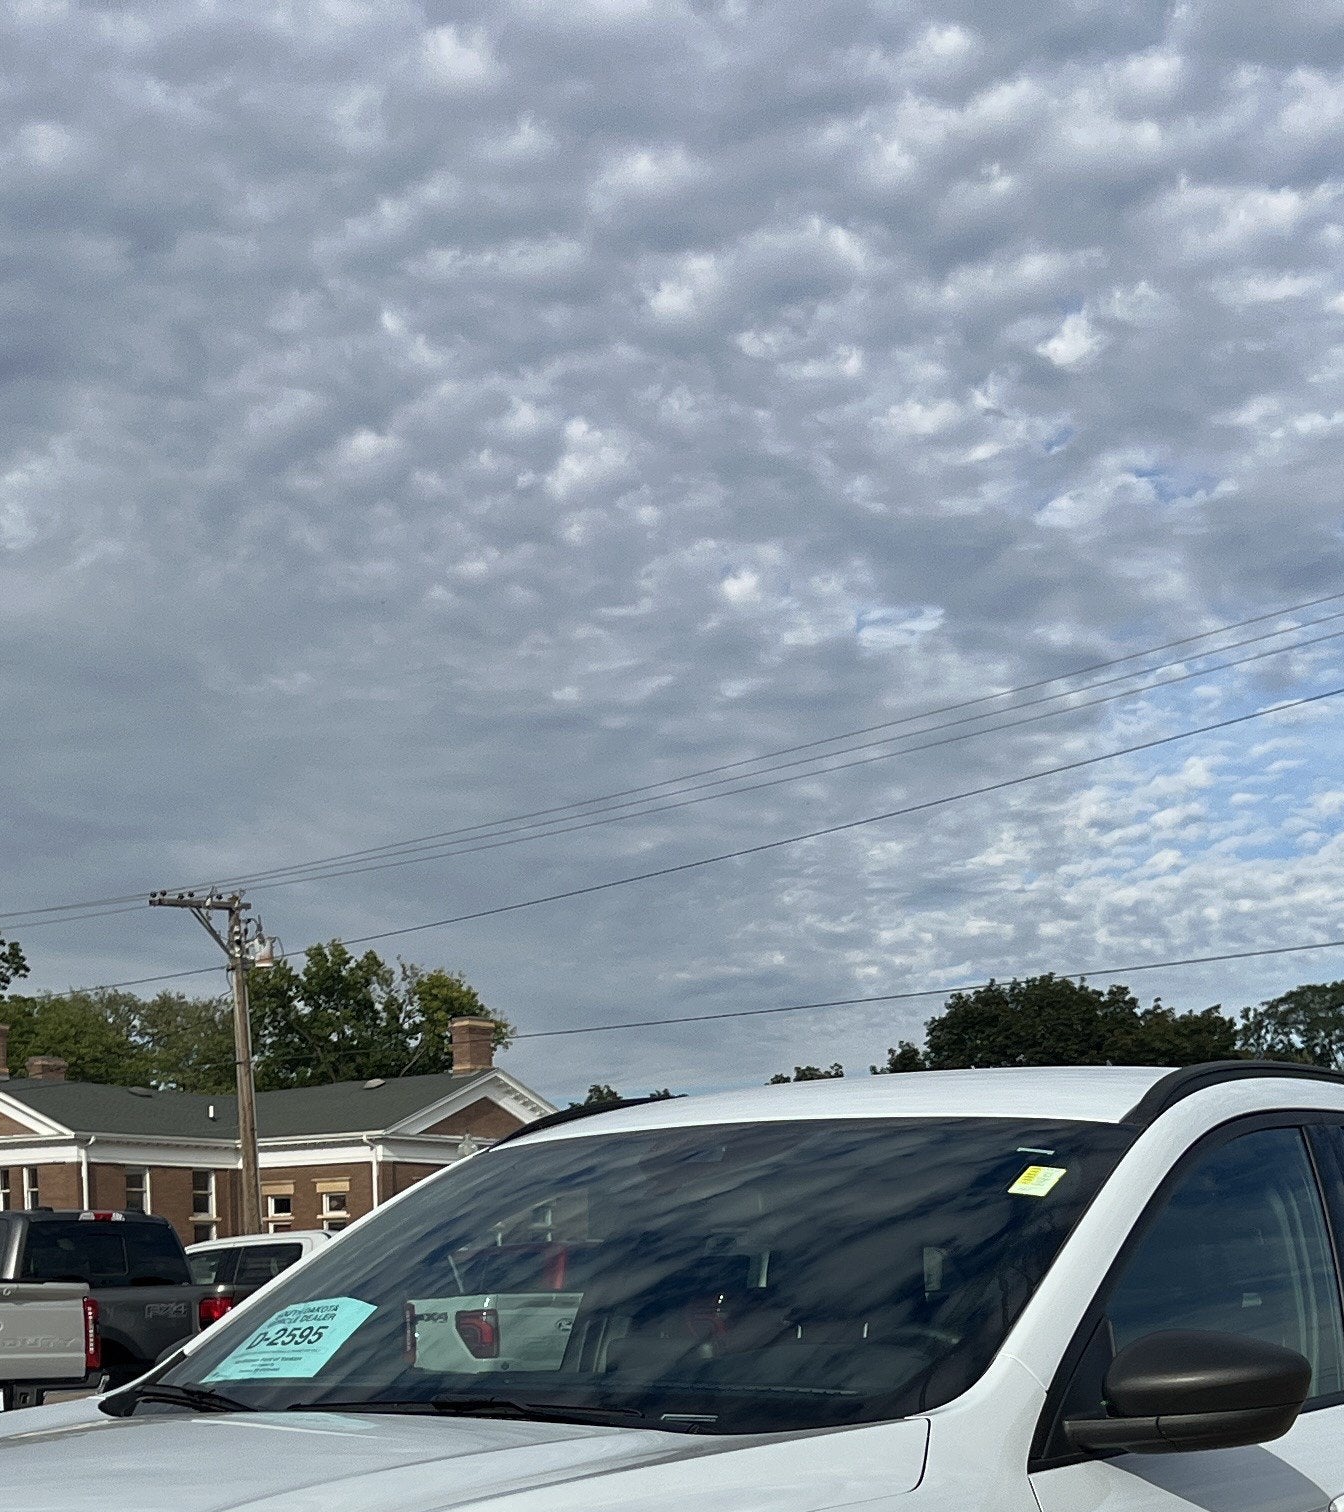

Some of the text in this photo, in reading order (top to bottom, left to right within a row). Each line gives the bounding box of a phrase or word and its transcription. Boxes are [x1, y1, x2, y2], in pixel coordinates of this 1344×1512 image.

[145, 1303, 186, 1318] FX4
[304, 1304, 340, 1315] DAKOTA
[300, 1313, 337, 1323] DEALER
[246, 1326, 329, 1350] D-2595
